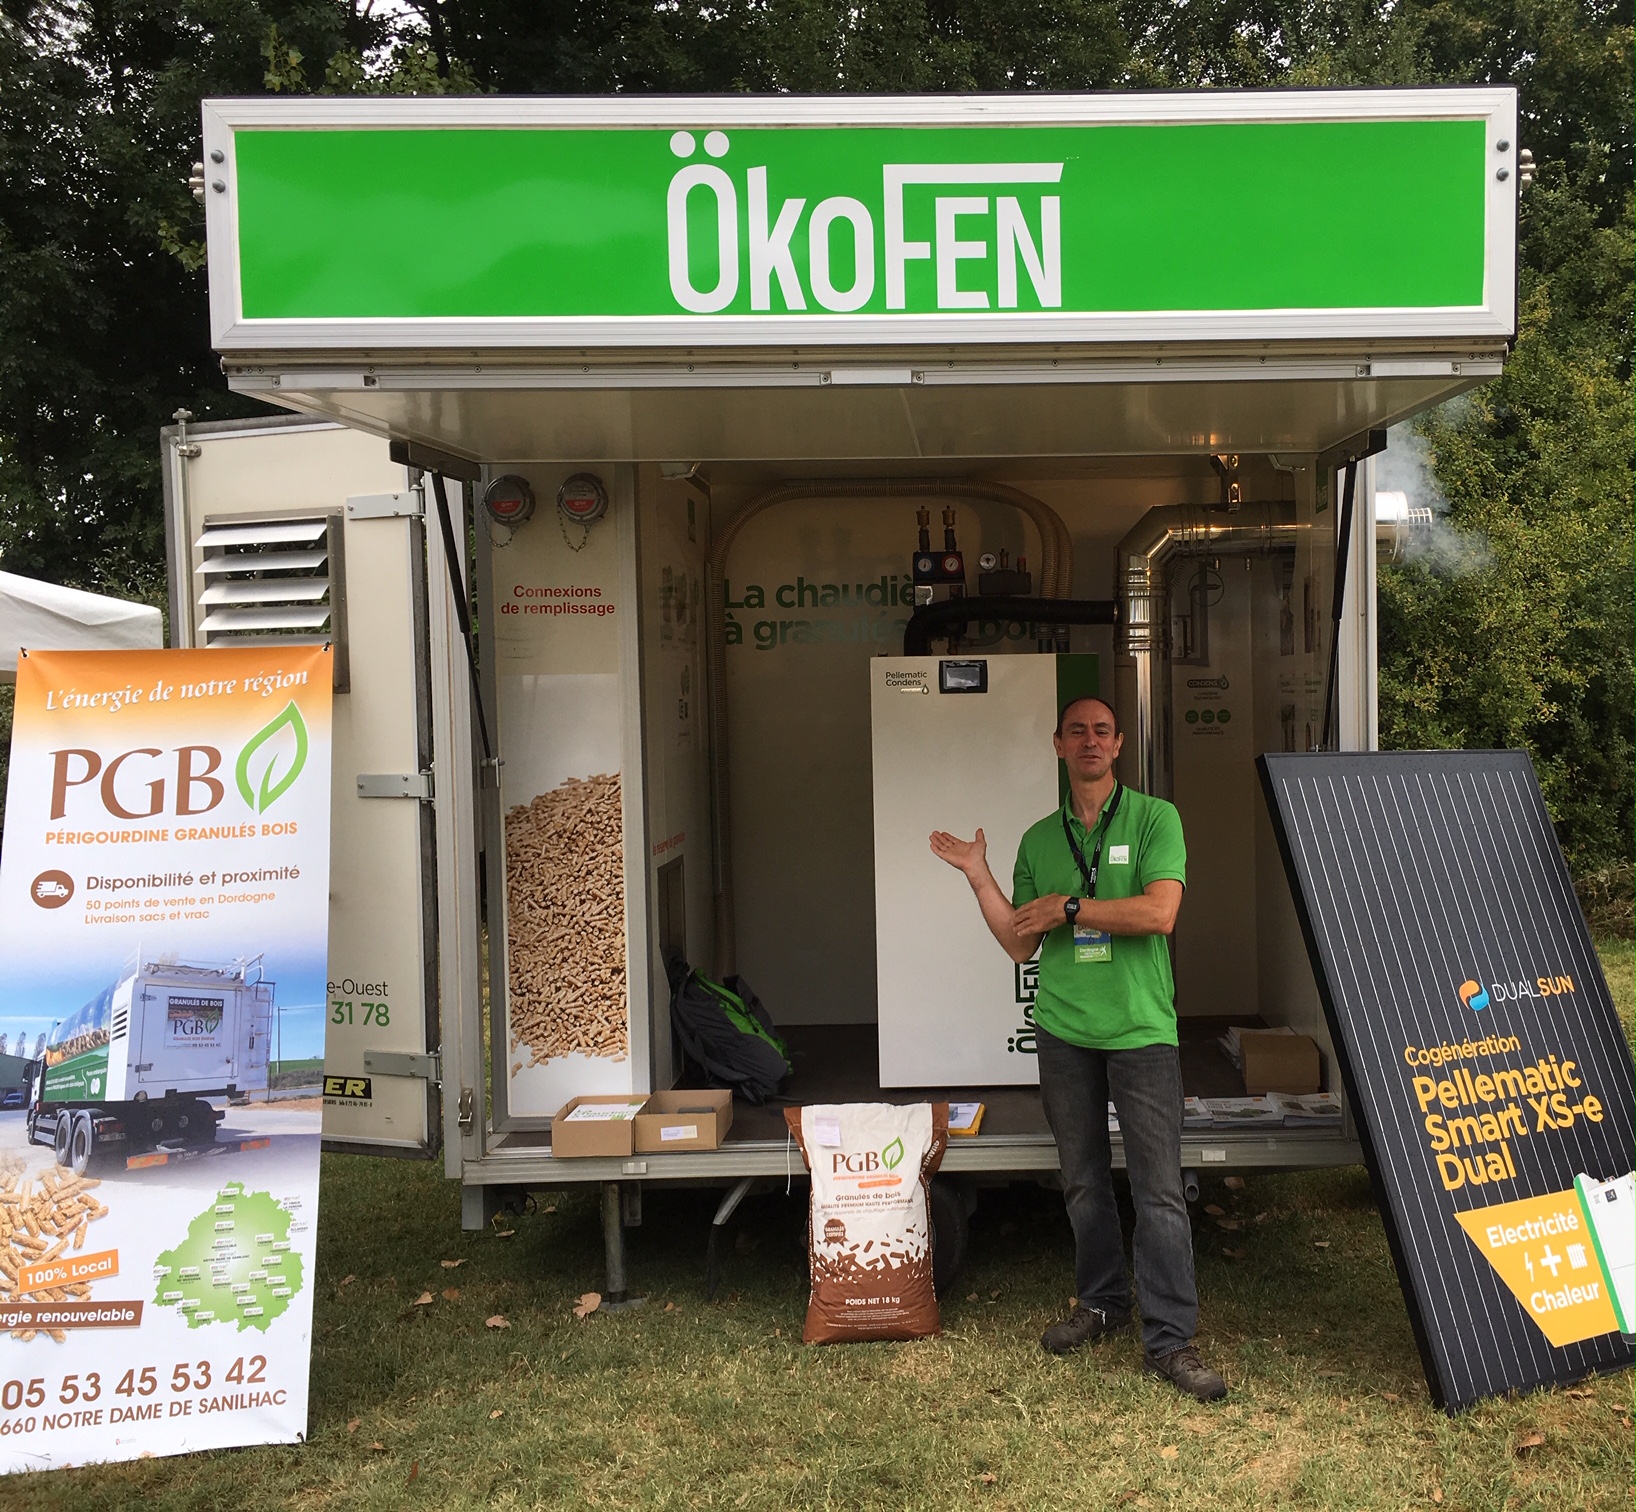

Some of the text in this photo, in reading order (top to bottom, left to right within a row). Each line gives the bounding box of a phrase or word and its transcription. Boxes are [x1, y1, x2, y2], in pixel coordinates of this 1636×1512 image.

[513, 586, 602, 598] Connexions
[723, 578, 765, 608] La
[501, 602, 615, 616] de remplissage
[724, 612, 743, 645] à
[885, 671, 928, 680] Pellematic
[886, 679, 922, 687] Condens
[46, 670, 308, 712] L'énergie de notre région
[48, 745, 225, 821] PGB
[45, 821, 298, 845] PÉRIGOURDINE GRANULÉS BOIS
[86, 864, 301, 892] Disponibilité et proximité
[85, 891, 276, 912] 50 points de vente en Dordogne
[84, 910, 210, 925] Livraison sacs et vrac
[327, 978, 389, 997] e-Ouest
[1492, 975, 1575, 1002] DUALSUN
[174, 1019, 203, 1035] PGB
[361, 1002, 390, 1027] 78
[1404, 1034, 1521, 1066] Cogénération
[1412, 1054, 1582, 1112] Pellematic
[1425, 1093, 1604, 1151] Smart XS-e
[832, 1151, 880, 1173] PGB
[1435, 1141, 1517, 1191] Dual
[835, 1191, 901, 1202] Granulés de bois
[1486, 1208, 1579, 1249] Electricité
[27, 1257, 112, 1286] 100% Local
[845, 1298, 866, 1306] POIDS
[892, 1296, 900, 1304] kg
[1530, 1282, 1600, 1314] Chaleur
[36, 1308, 135, 1323] renouvelable
[1, 1354, 268, 1411] 05 53 45 53 42
[42, 1409, 104, 1431] NOTRE
[109, 1402, 163, 1424] DAME
[169, 1400, 193, 1418] DE
[198, 1389, 288, 1414] SANILHAC
